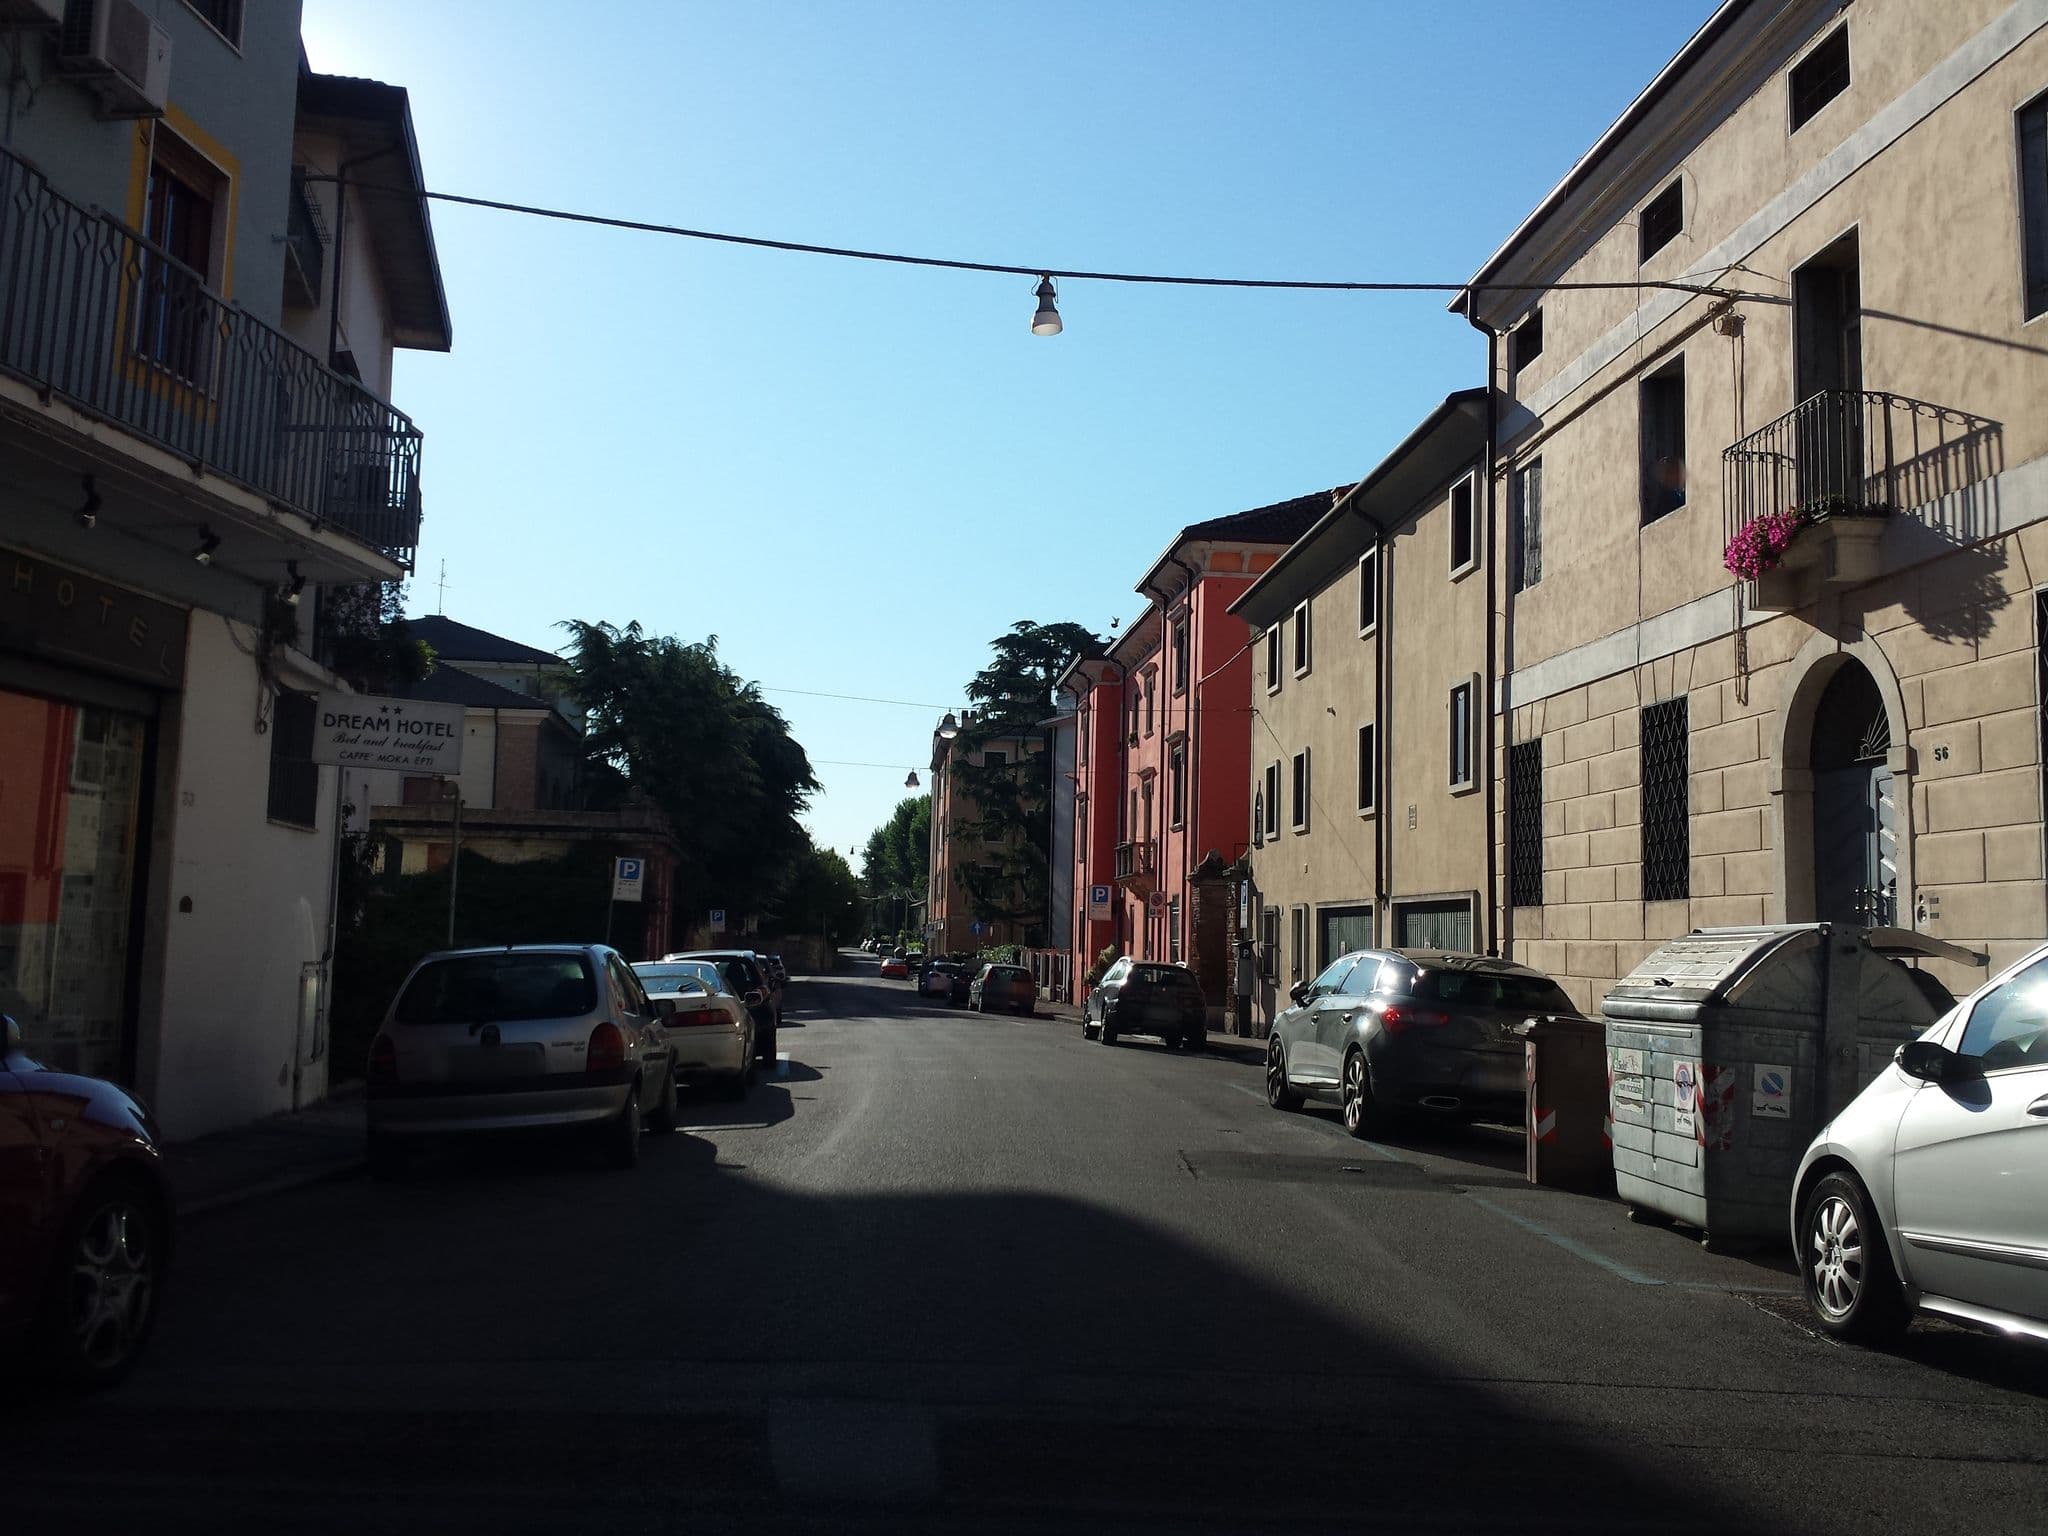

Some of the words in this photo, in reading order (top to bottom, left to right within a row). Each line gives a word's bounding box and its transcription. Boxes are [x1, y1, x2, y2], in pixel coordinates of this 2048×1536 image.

[14, 559, 174, 678] HOTEL
[323, 713, 390, 732] DREAM
[397, 719, 455, 738] HOTEL
[332, 732, 361, 745] Bed
[363, 738, 388, 747] and
[393, 738, 444, 754] breakfast
[377, 754, 409, 764] MOKA
[1934, 746, 1949, 762] 56
[623, 862, 636, 877] P
[1095, 888, 1106, 902] P
